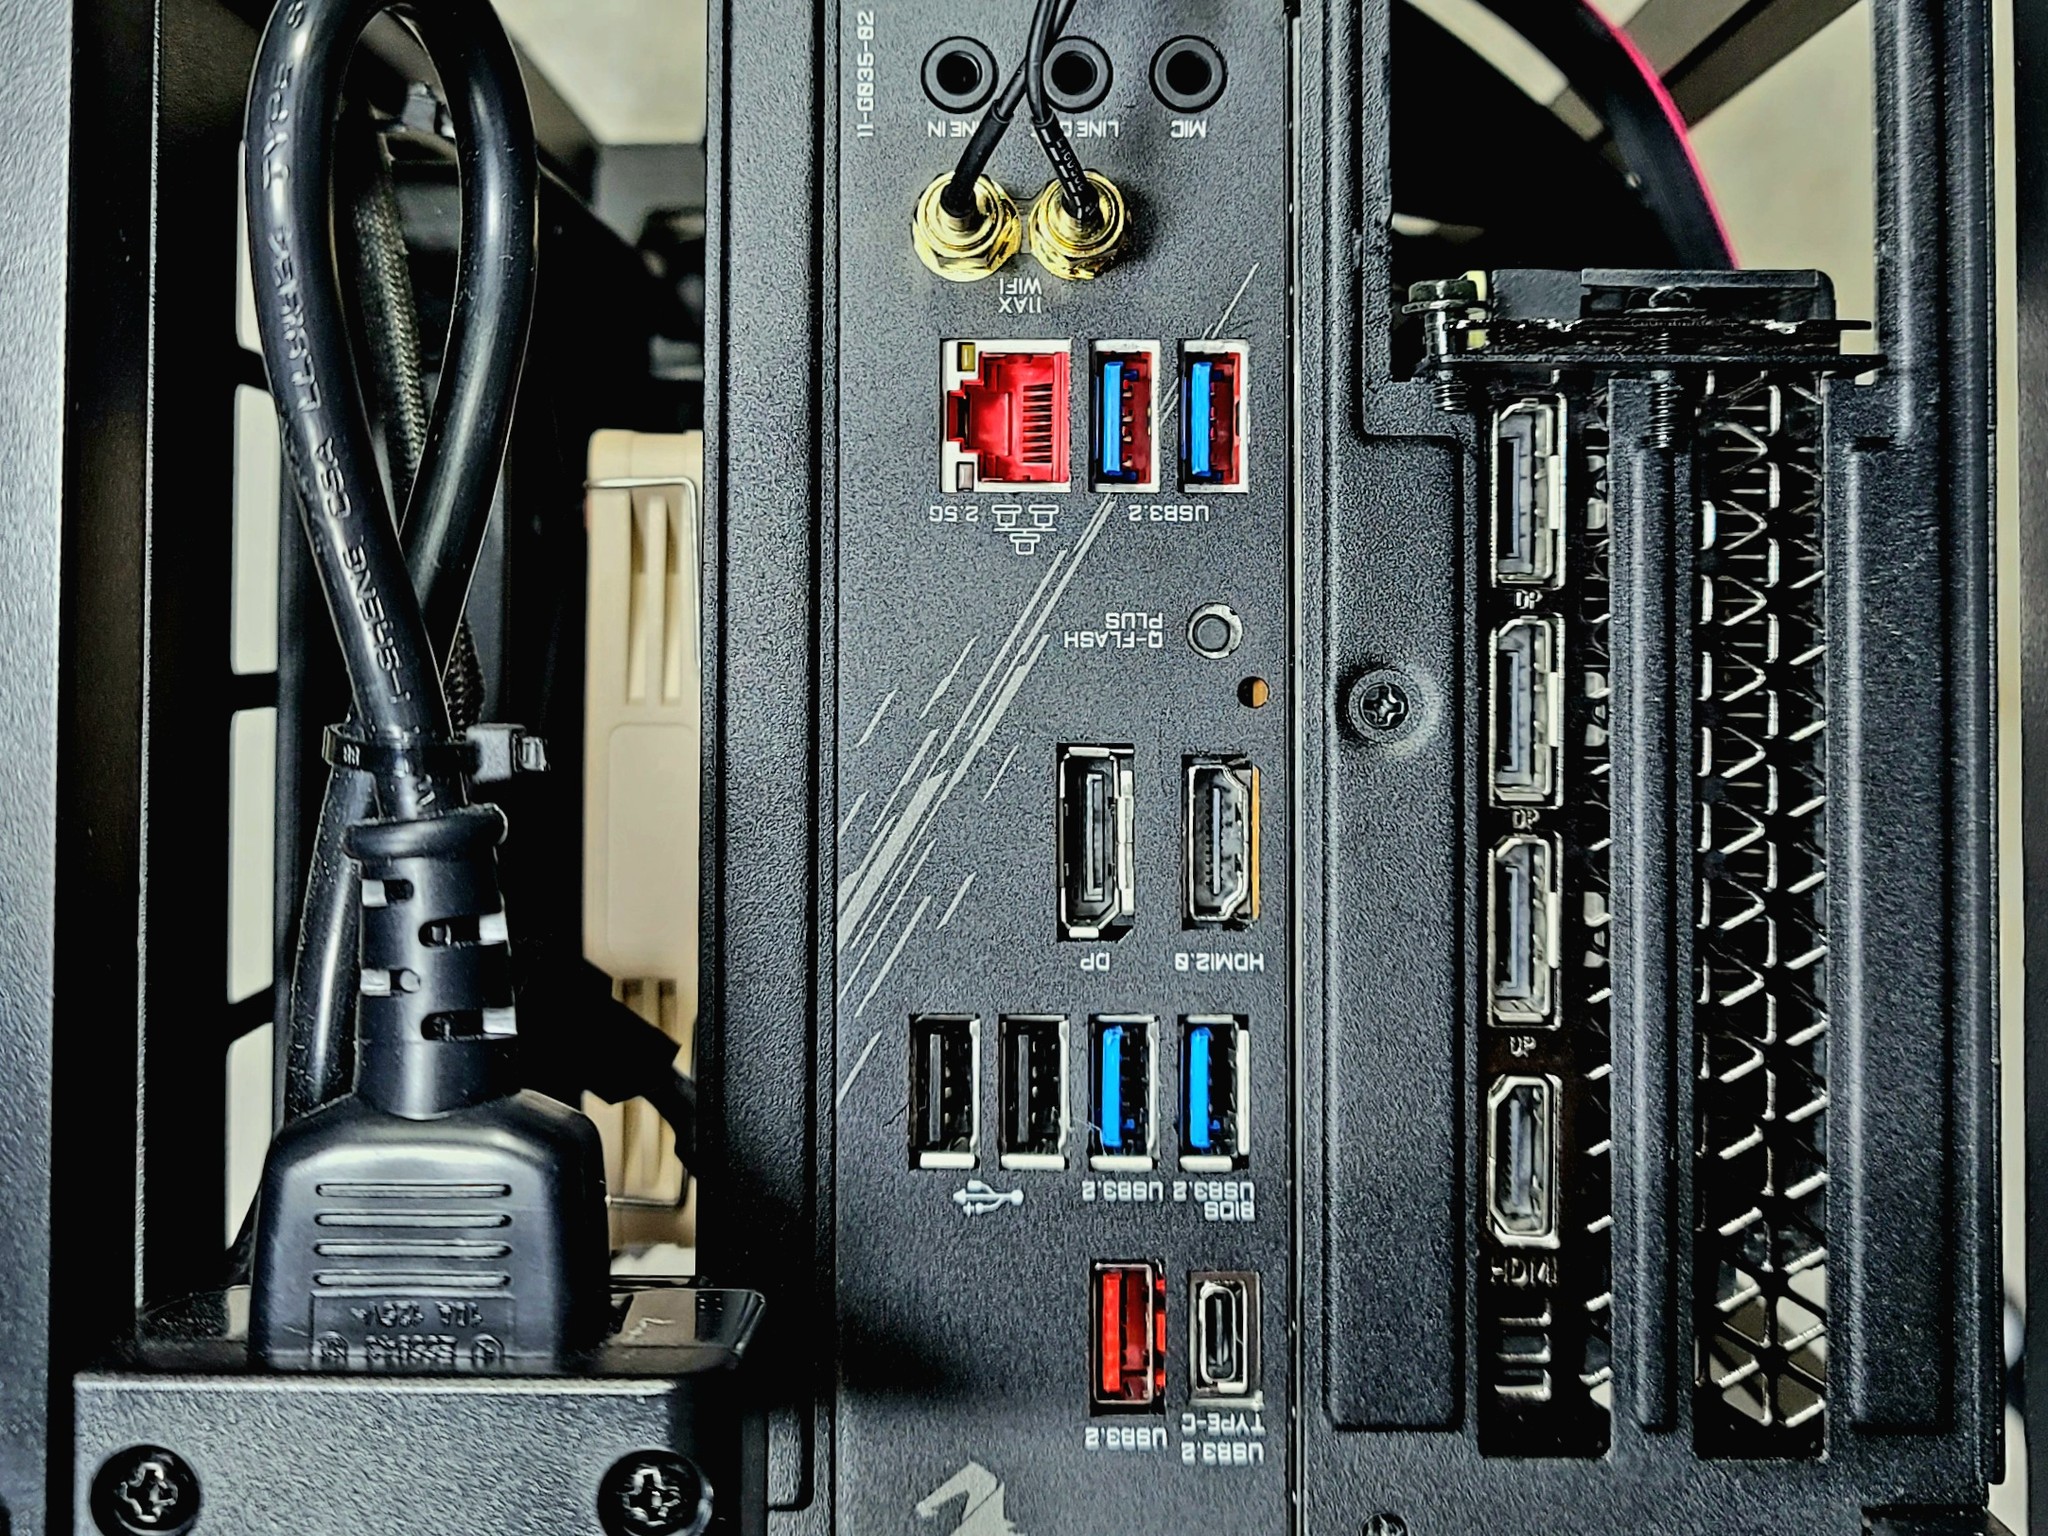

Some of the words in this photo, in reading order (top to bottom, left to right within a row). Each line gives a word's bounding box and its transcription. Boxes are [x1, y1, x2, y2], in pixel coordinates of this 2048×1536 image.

[857, 10, 875, 138] 11-G035-02
[261, 61, 294, 189] TYPE
[928, 120, 947, 137] IN
[1076, 120, 1120, 137] LINE
[1170, 119, 1207, 138] MIC
[999, 278, 1042, 295] WIFI
[999, 297, 1042, 314] 11AX
[315, 437, 351, 519] CSA
[929, 504, 979, 522] 2.5G
[1128, 504, 1210, 522] USB3.2
[1516, 588, 1543, 610] DP
[1105, 612, 1163, 630] PLUS
[1064, 630, 1163, 648] Q-FLASH
[1512, 809, 1540, 830] DP
[1081, 953, 1110, 971] DP
[1175, 953, 1265, 972] HDMI2.0
[1082, 1181, 1164, 1201] USB3.2
[1173, 1181, 1255, 1201] USB3.2
[1203, 1201, 1255, 1221] BIOS
[1491, 1256, 1558, 1287] HDMI
[1181, 1412, 1265, 1438] TYPE-C
[1085, 1427, 1168, 1451] USB3.2
[1181, 1441, 1265, 1466] USB3.2
